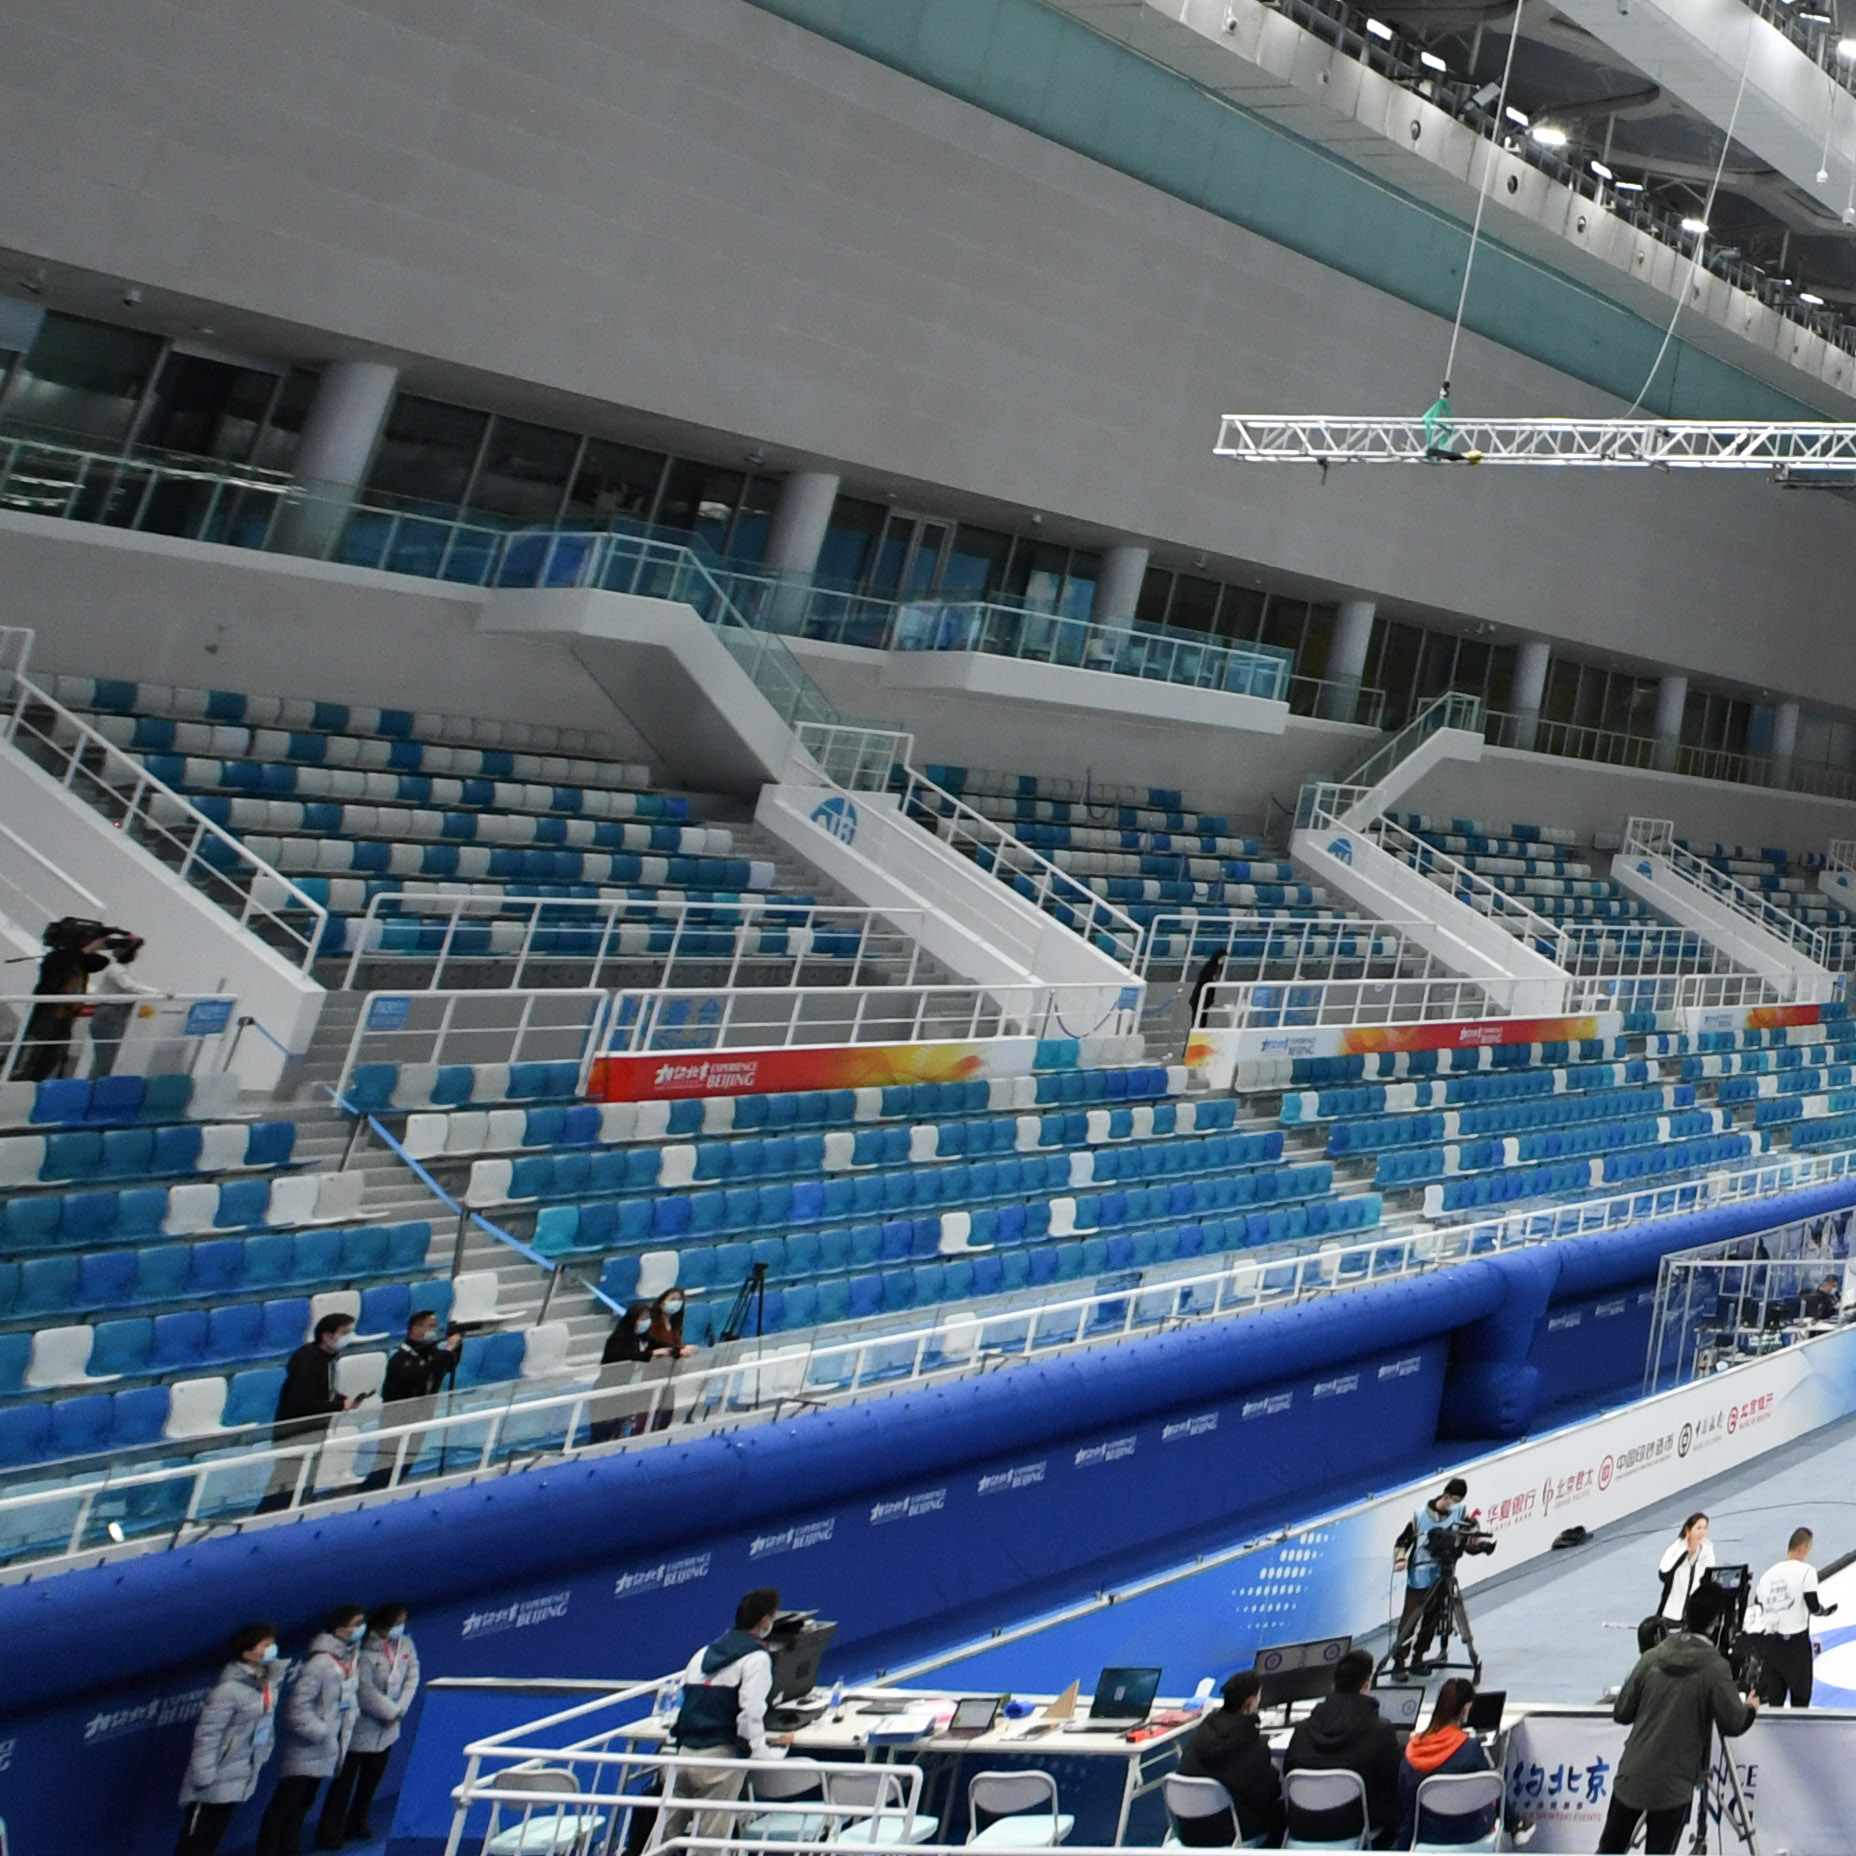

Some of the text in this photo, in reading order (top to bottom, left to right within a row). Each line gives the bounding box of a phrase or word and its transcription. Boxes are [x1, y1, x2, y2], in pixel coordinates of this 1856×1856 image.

[706, 1072, 756, 1088] BEIJING
[1486, 1488, 1537, 1525] 华夏银行
[1503, 1756, 1610, 1805] 约北京
